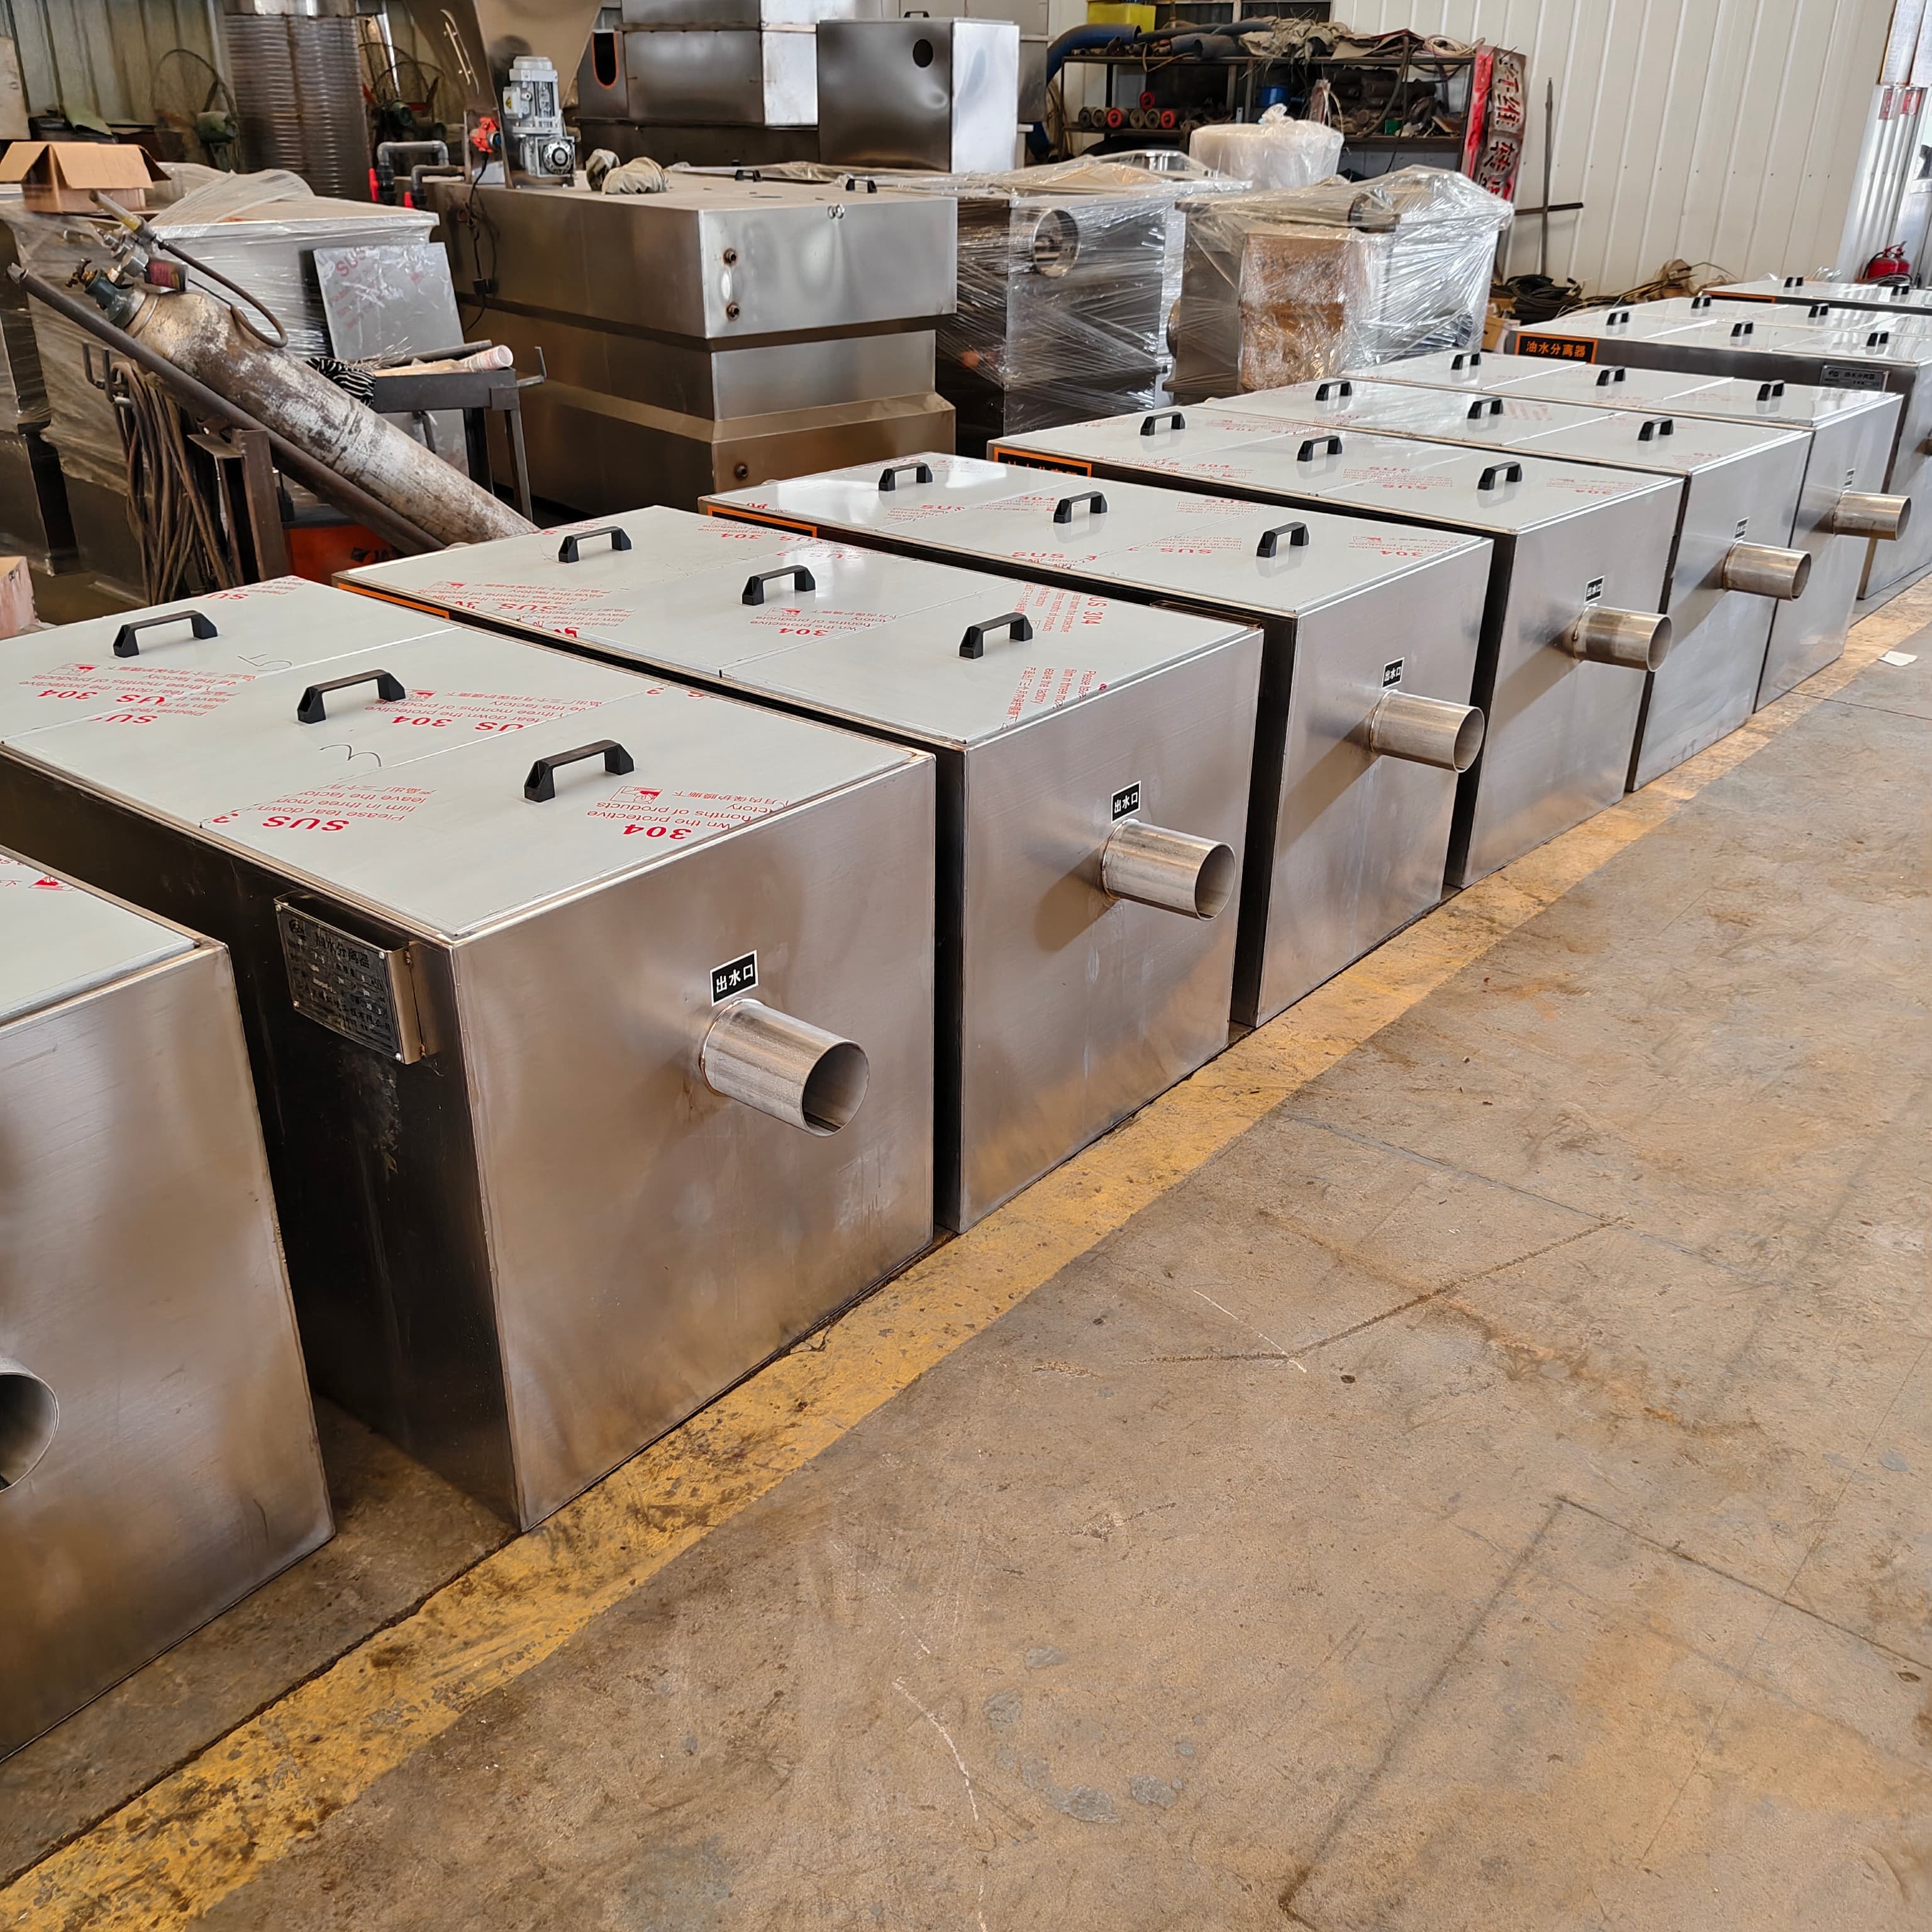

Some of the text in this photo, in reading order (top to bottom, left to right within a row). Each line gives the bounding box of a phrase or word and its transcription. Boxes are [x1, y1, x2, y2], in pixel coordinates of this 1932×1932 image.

[1526, 340, 1585, 357] 油水分离器
[496, 603, 558, 613] SUS
[1082, 611, 1103, 625] 304
[778, 628, 829, 636] 304
[1384, 667, 1401, 682] 出水口
[19, 680, 89, 690] protective
[36, 689, 98, 699] 304
[458, 704, 514, 714] months
[489, 700, 540, 709] factory
[364, 705, 441, 717] protective
[440, 710, 464, 718] the
[517, 708, 555, 718] three
[391, 716, 453, 728] 304
[348, 792, 377, 802] the
[380, 794, 427, 804] leave
[318, 799, 362, 809] three
[595, 801, 670, 814] products
[1114, 792, 1138, 813] 出水口
[257, 805, 406, 822] Please tear down
[385, 804, 416, 813] film
[675, 808, 690, 817] of
[586, 810, 671, 824] protective
[262, 816, 350, 832] SUS
[674, 818, 701, 828] the
[623, 824, 692, 840] 304
[716, 963, 753, 993] 出水口
